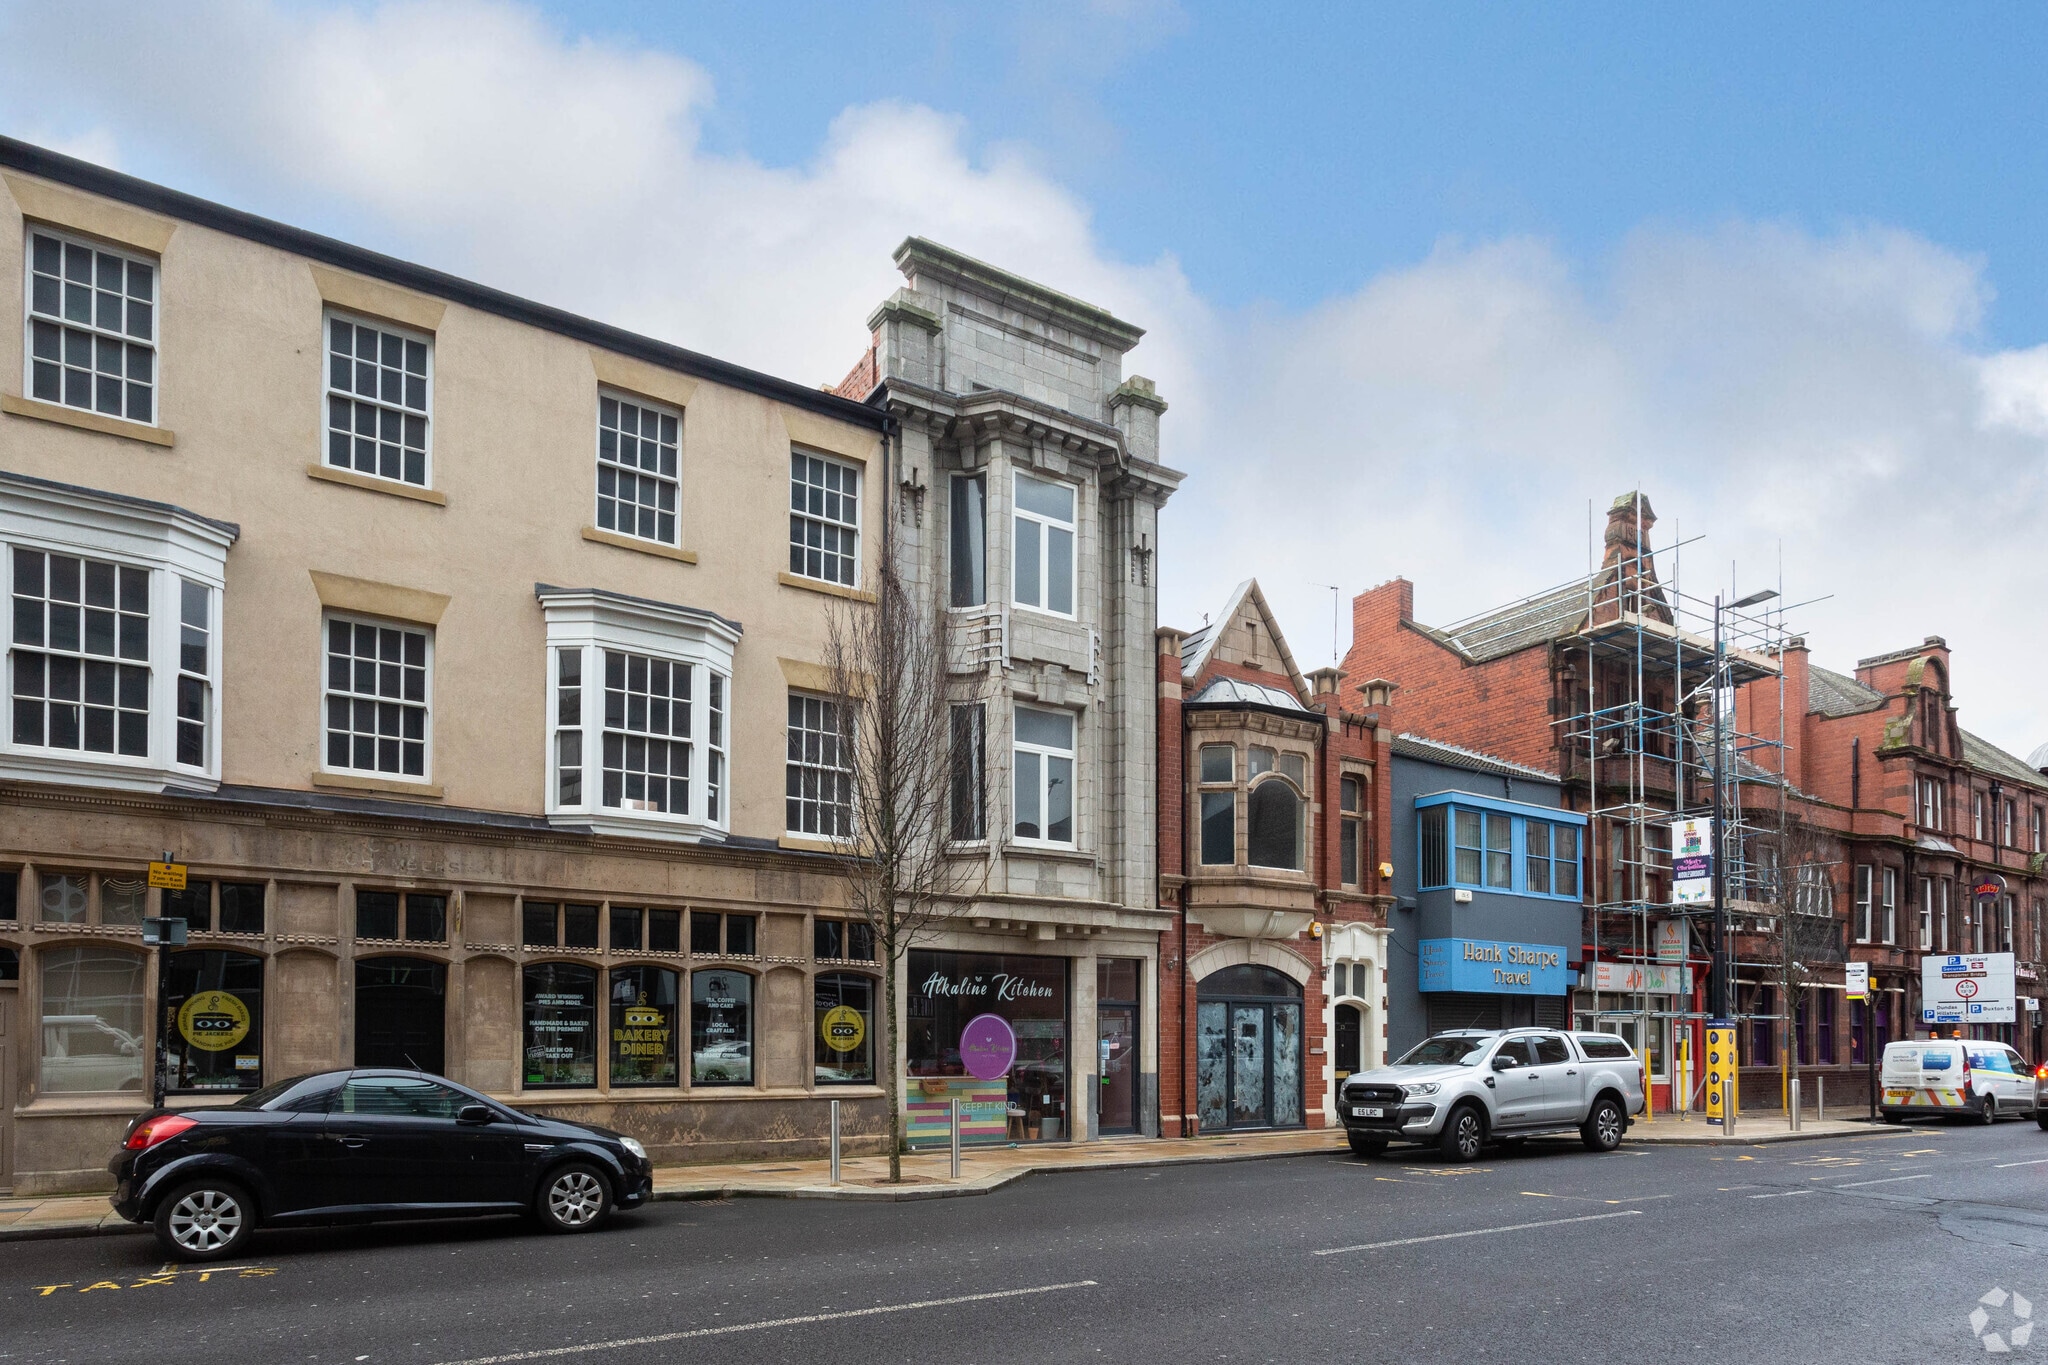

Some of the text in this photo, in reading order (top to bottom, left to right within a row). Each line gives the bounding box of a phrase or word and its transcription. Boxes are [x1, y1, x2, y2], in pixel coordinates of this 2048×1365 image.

[1463, 942, 1559, 970] Hank Sharpe
[1492, 968, 1532, 985] Travel
[922, 971, 1053, 1001] Alkaline Kitchen
[614, 1028, 670, 1042] BAKERY
[620, 1042, 664, 1055] DINER
[960, 1101, 1017, 1112] KEEP IT KIND
